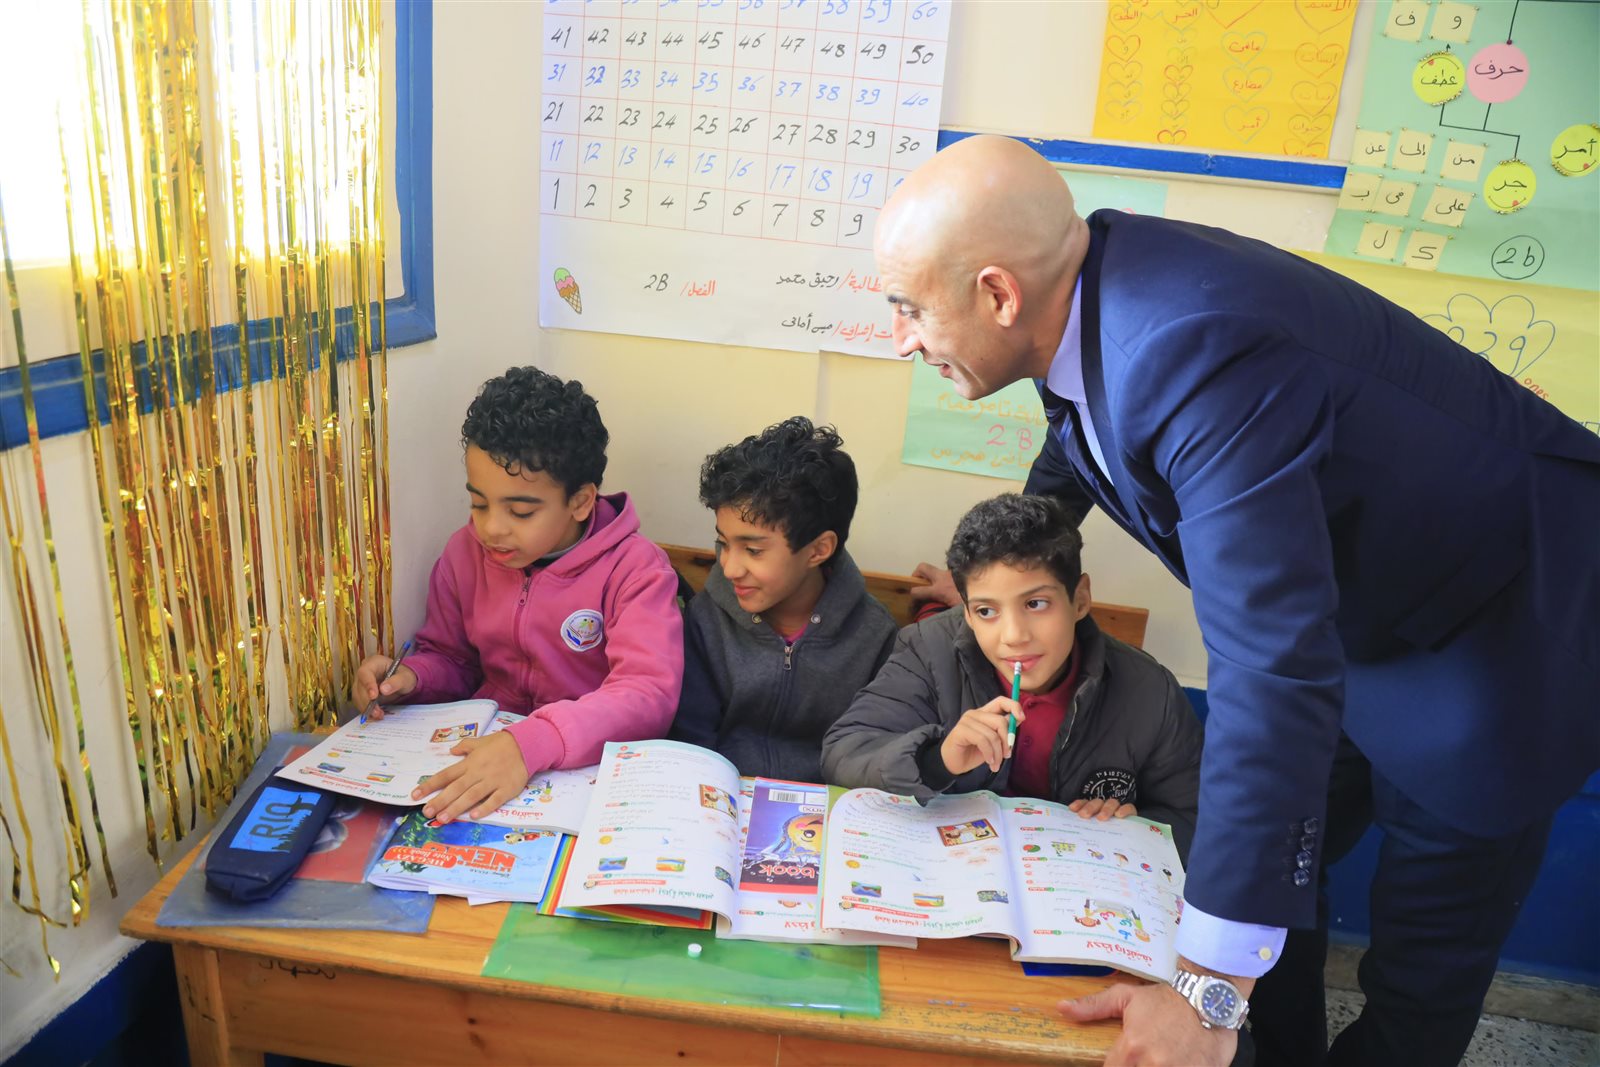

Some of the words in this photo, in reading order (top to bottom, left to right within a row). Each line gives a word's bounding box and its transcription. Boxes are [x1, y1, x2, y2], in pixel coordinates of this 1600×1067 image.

[863, 0, 891, 23] 59
[912, 1, 938, 20] 60
[1395, 11, 1415, 25] ف
[1451, 15, 1461, 29] و
[551, 26, 571, 48] 41
[588, 28, 609, 43] 42
[626, 31, 647, 45] 43
[662, 31, 684, 47] 44
[698, 31, 723, 49] 45
[738, 32, 766, 48] 46
[780, 35, 805, 53] 47
[820, 42, 846, 58] 48
[860, 42, 887, 59] 49
[906, 45, 934, 64] 50
[1421, 69, 1458, 86] عطف
[1475, 60, 1524, 80] حرف
[548, 64, 567, 82] 31
[585, 65, 606, 87] 32
[621, 69, 641, 88] 33
[656, 70, 679, 88] 34
[692, 72, 719, 92] 35
[738, 75, 765, 92] 36
[776, 81, 802, 97] 37
[816, 84, 840, 101] 38
[856, 88, 881, 105] 39
[902, 92, 929, 106] 40
[543, 101, 565, 122] 21
[584, 105, 604, 123] 22
[619, 107, 641, 126] 23
[652, 111, 677, 129] 24
[693, 114, 719, 135] 25
[729, 117, 758, 134] 26
[772, 124, 802, 145] 27
[808, 124, 838, 144] 28
[848, 129, 876, 148] 29
[896, 136, 920, 154] 30
[1365, 144, 1386, 155] عن
[1554, 138, 1598, 158] أمر
[1453, 152, 1475, 165] من
[550, 139, 564, 162] 11
[583, 142, 601, 164] 12
[618, 145, 638, 167] 13
[654, 148, 676, 169] 14
[694, 152, 717, 173] 15
[728, 158, 755, 180] 16
[770, 163, 797, 190] 17
[808, 167, 833, 192] 18
[847, 172, 873, 199] 19
[1351, 190, 1370, 200] ب
[1493, 179, 1527, 193] جر
[553, 178, 560, 210] 1
[584, 183, 597, 209] 2
[619, 188, 633, 209] 3
[660, 195, 674, 209] 4
[693, 191, 711, 211] 5
[732, 200, 751, 216] 6
[772, 203, 789, 227] 7
[810, 209, 826, 227] 8
[845, 214, 863, 237] 9
[1373, 230, 1389, 249] ل
[1496, 246, 1535, 266] 2b
[643, 273, 669, 291] 2B
[776, 273, 806, 285] محمد
[758, 864, 815, 879] book
